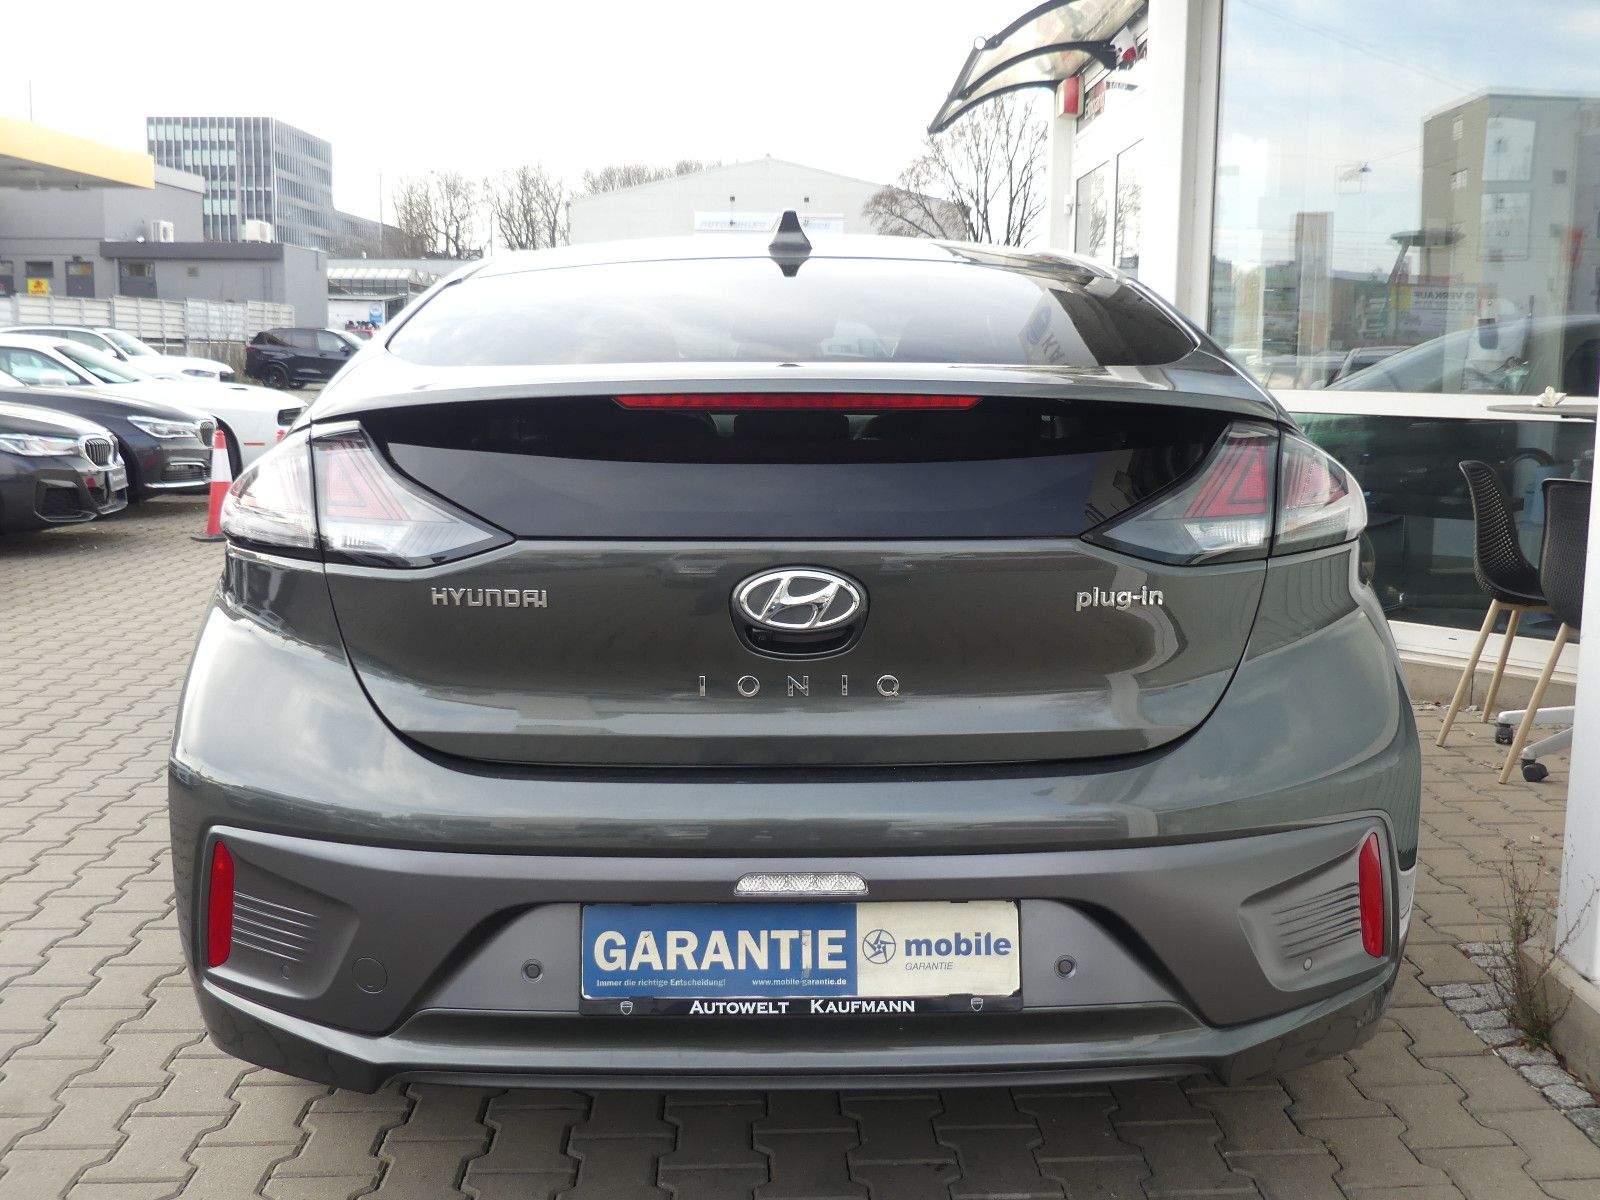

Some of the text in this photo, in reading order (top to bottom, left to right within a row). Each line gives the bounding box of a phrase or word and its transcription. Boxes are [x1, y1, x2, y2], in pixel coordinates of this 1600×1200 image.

[431, 587, 548, 608] HYUNDAI
[1075, 585, 1164, 612] plug-in
[698, 674, 902, 697] IONIQ
[593, 929, 847, 971] GARANTIE
[904, 932, 1012, 957] mobile
[904, 961, 954, 971] GARANTIE
[596, 978, 622, 988] Immer
[624, 978, 636, 987] die
[637, 978, 669, 989] richtige
[751, 976, 847, 988] www.mobile-garantie.de
[688, 999, 916, 1015] AUTOWELT KAUFMANN
